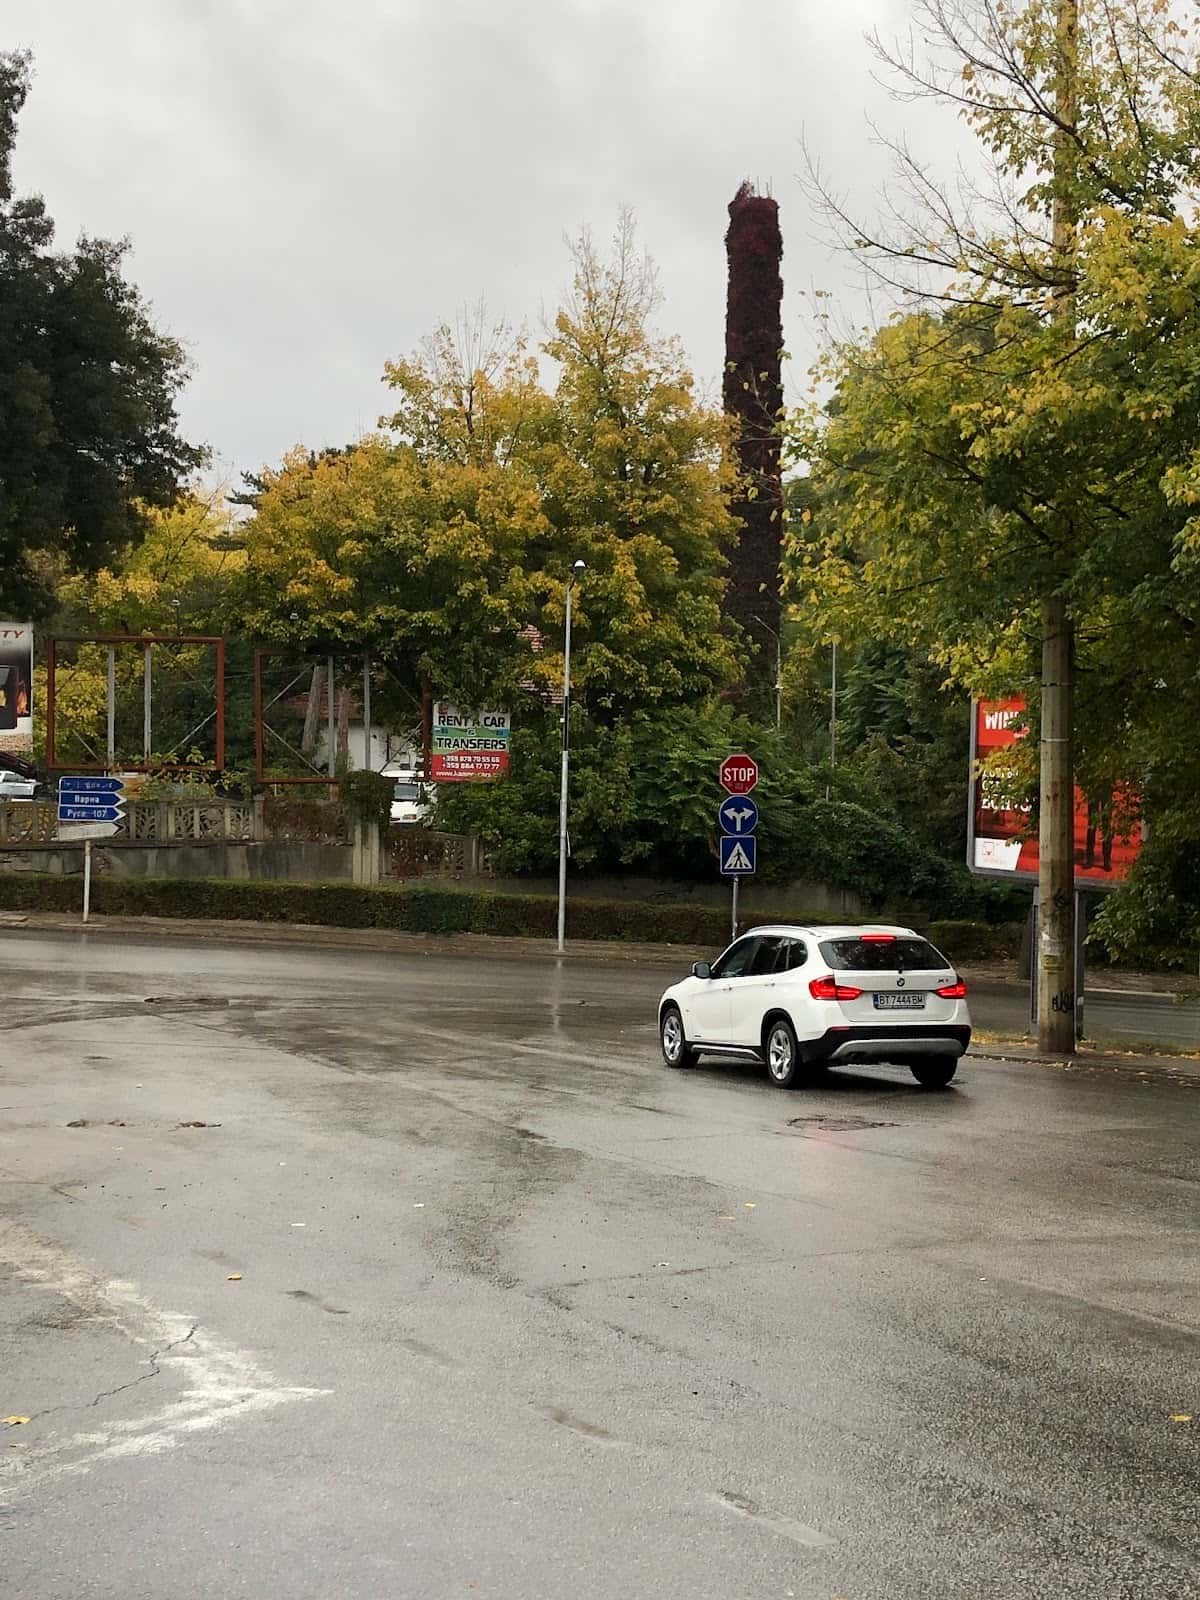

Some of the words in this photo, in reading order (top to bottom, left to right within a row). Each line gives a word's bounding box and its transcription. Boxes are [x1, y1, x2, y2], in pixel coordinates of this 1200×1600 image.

[438, 715, 469, 726] RENT
[483, 716, 506, 727] CAR
[436, 737, 506, 749] TRANSFERS
[724, 767, 755, 781] STOP
[74, 794, 100, 804] Варна
